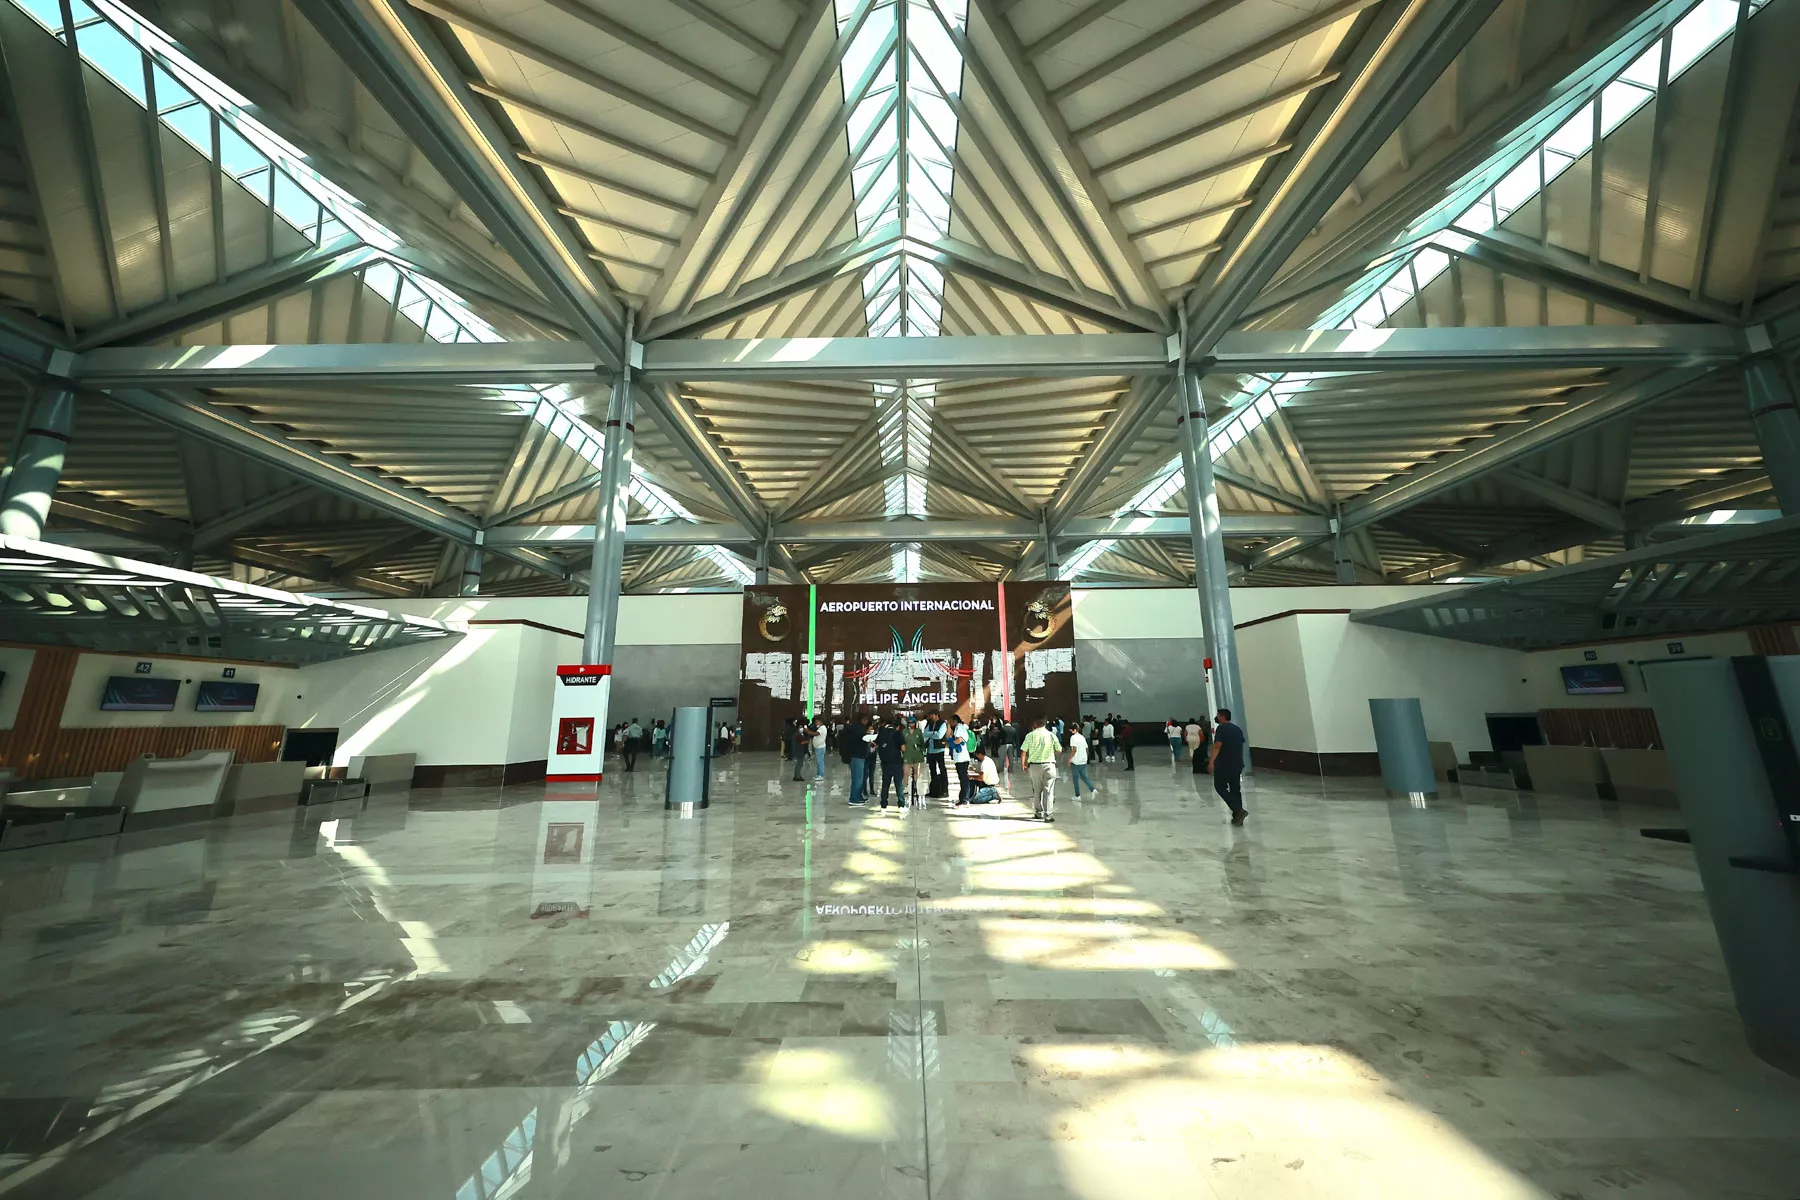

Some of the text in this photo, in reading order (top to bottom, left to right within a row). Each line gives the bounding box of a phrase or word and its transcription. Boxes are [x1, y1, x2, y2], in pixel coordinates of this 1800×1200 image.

[820, 599, 994, 613] AEROPUERTO INTERNACIONAL
[138, 664, 150, 672] 42
[565, 676, 597, 684] HIDRANTE
[859, 690, 957, 705] FELIPE ÁNGELES
